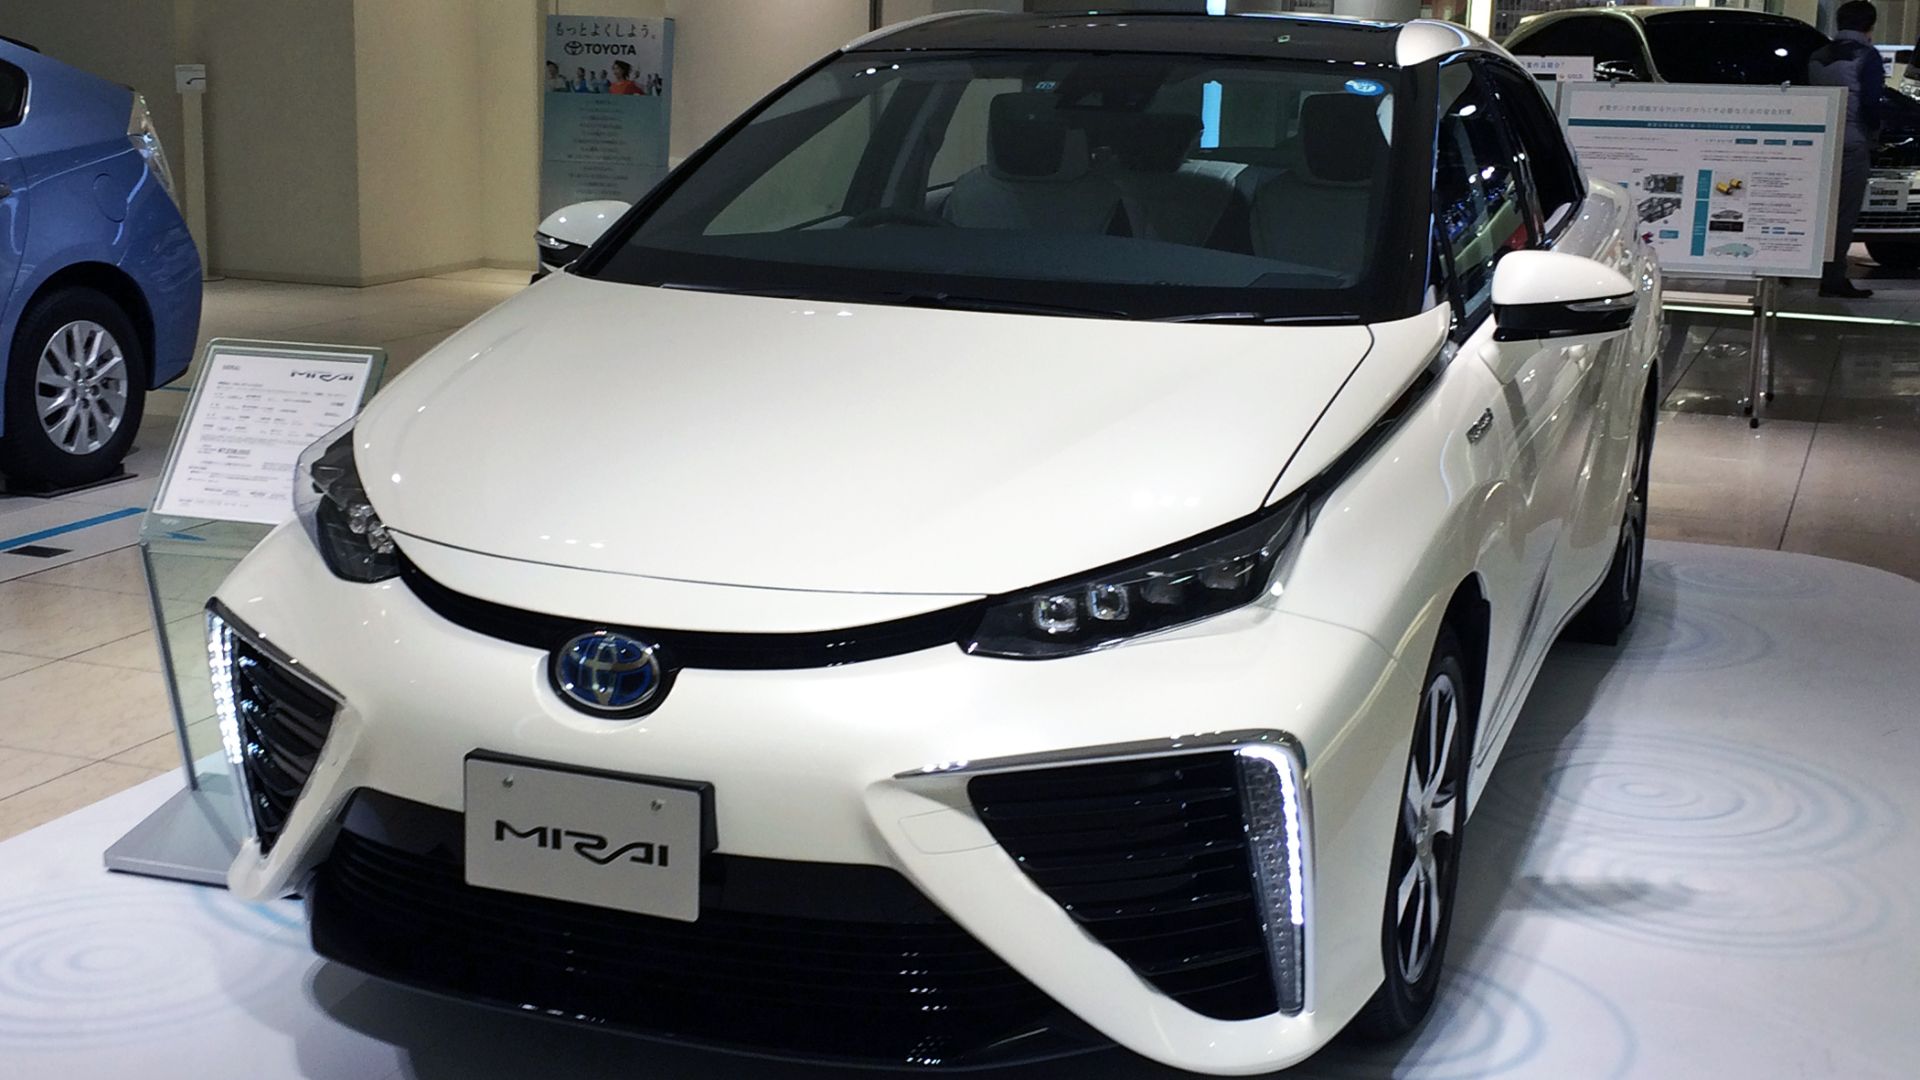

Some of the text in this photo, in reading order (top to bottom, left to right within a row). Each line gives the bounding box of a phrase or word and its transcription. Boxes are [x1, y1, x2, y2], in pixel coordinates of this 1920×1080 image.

[556, 22, 657, 39] もっとよくしよう。
[584, 43, 637, 55] TOYOTA
[290, 370, 353, 382] MIRAI
[495, 819, 669, 867] MIRAI
